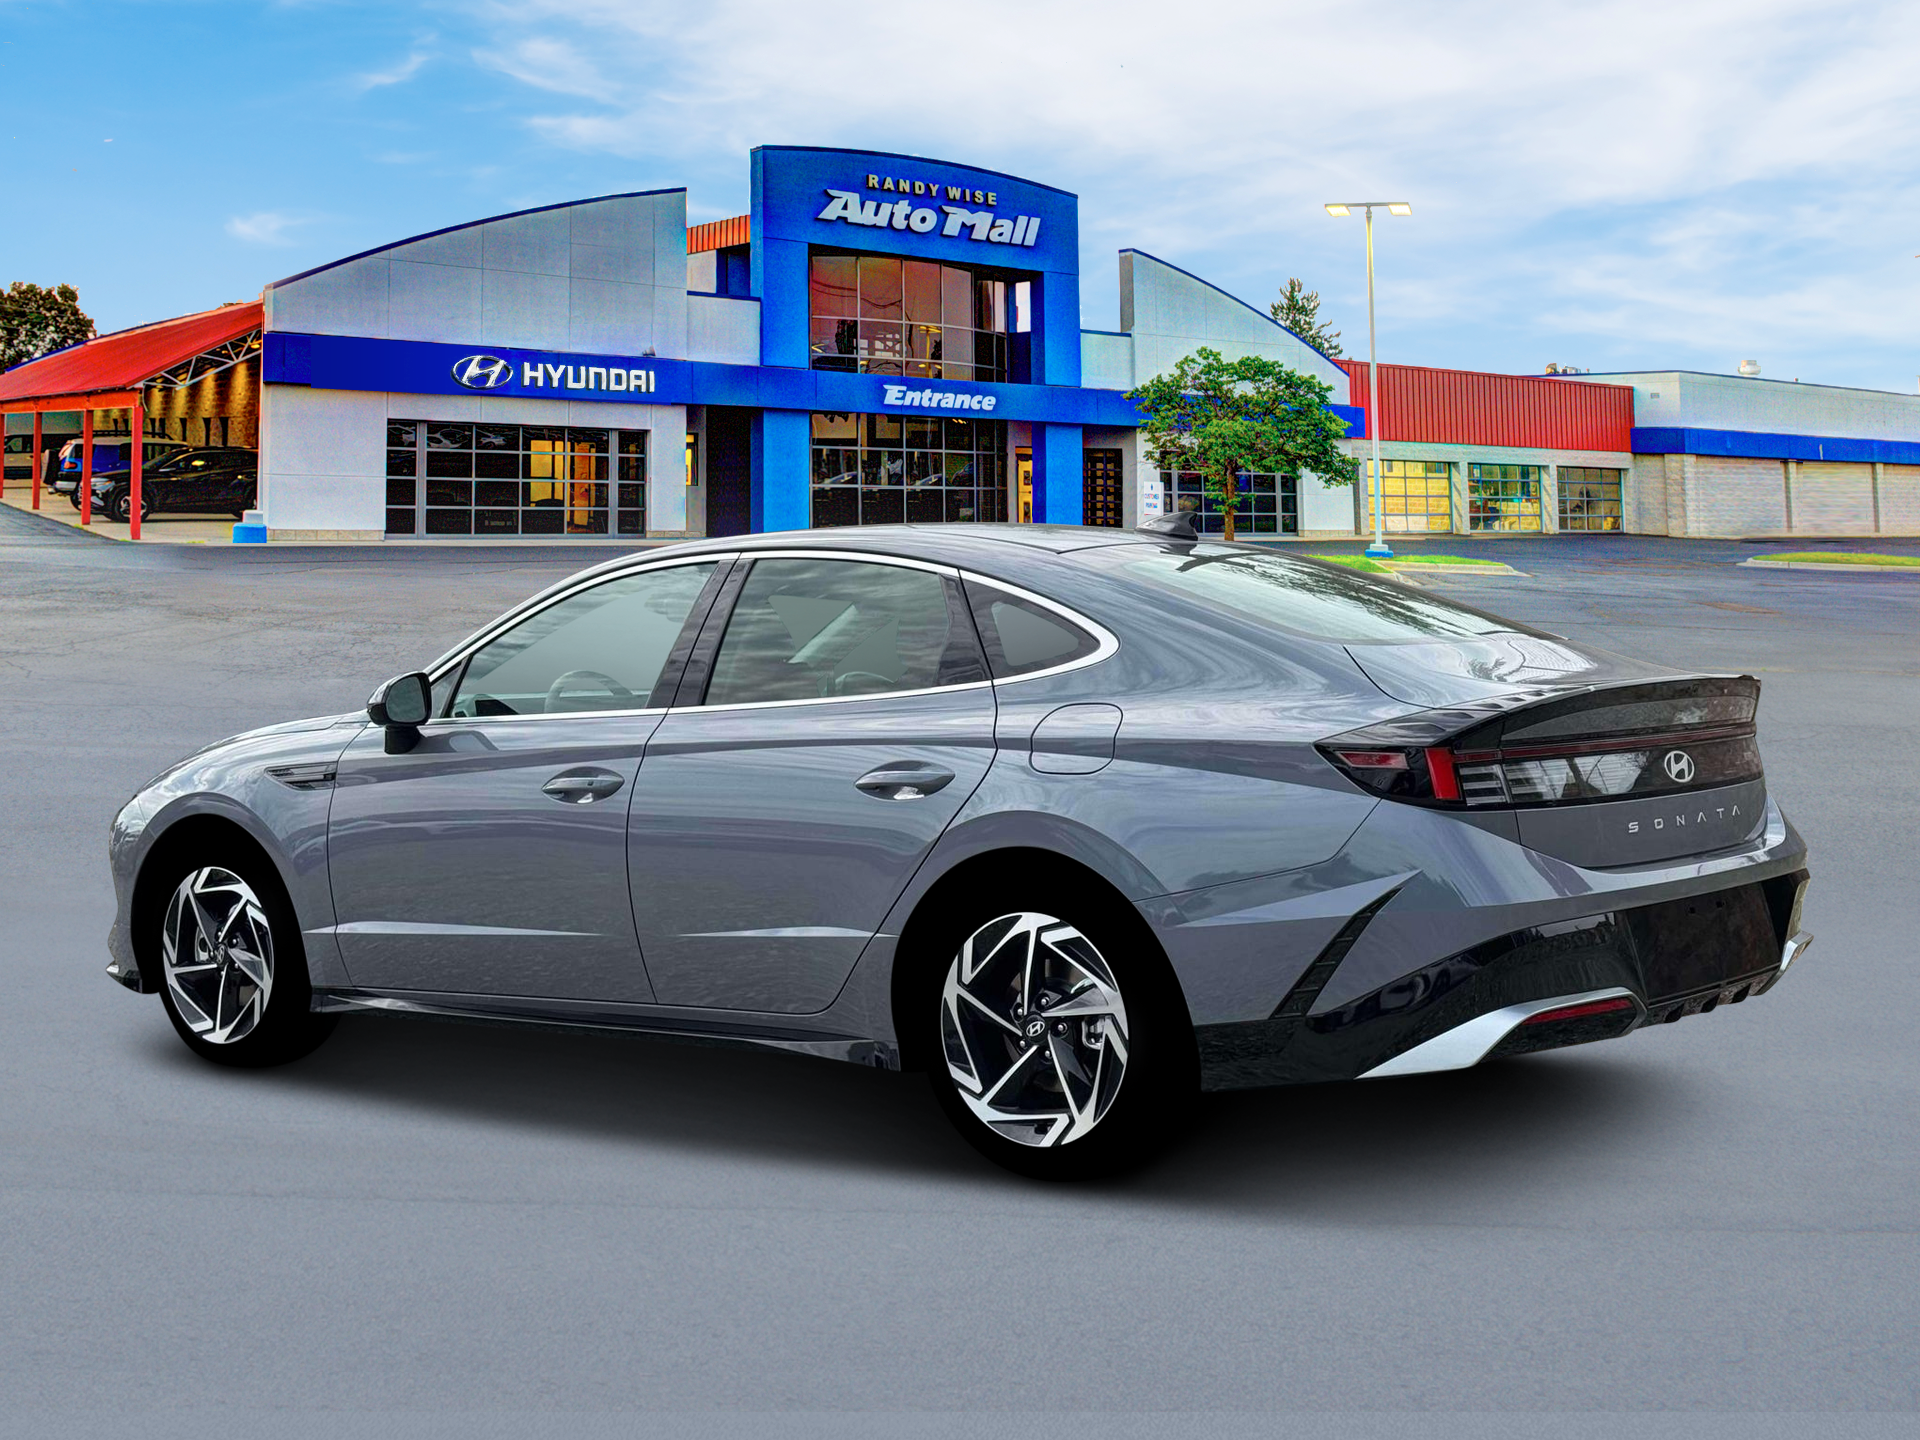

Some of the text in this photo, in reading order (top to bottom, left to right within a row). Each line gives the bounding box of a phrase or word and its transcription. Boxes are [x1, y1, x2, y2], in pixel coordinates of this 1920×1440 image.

[868, 174, 998, 205] RANDY WISE
[817, 188, 1041, 246] Auto Mall
[522, 361, 656, 393] HYUNDAI
[883, 384, 997, 411] Entrance
[1628, 805, 1741, 833] SONATA
